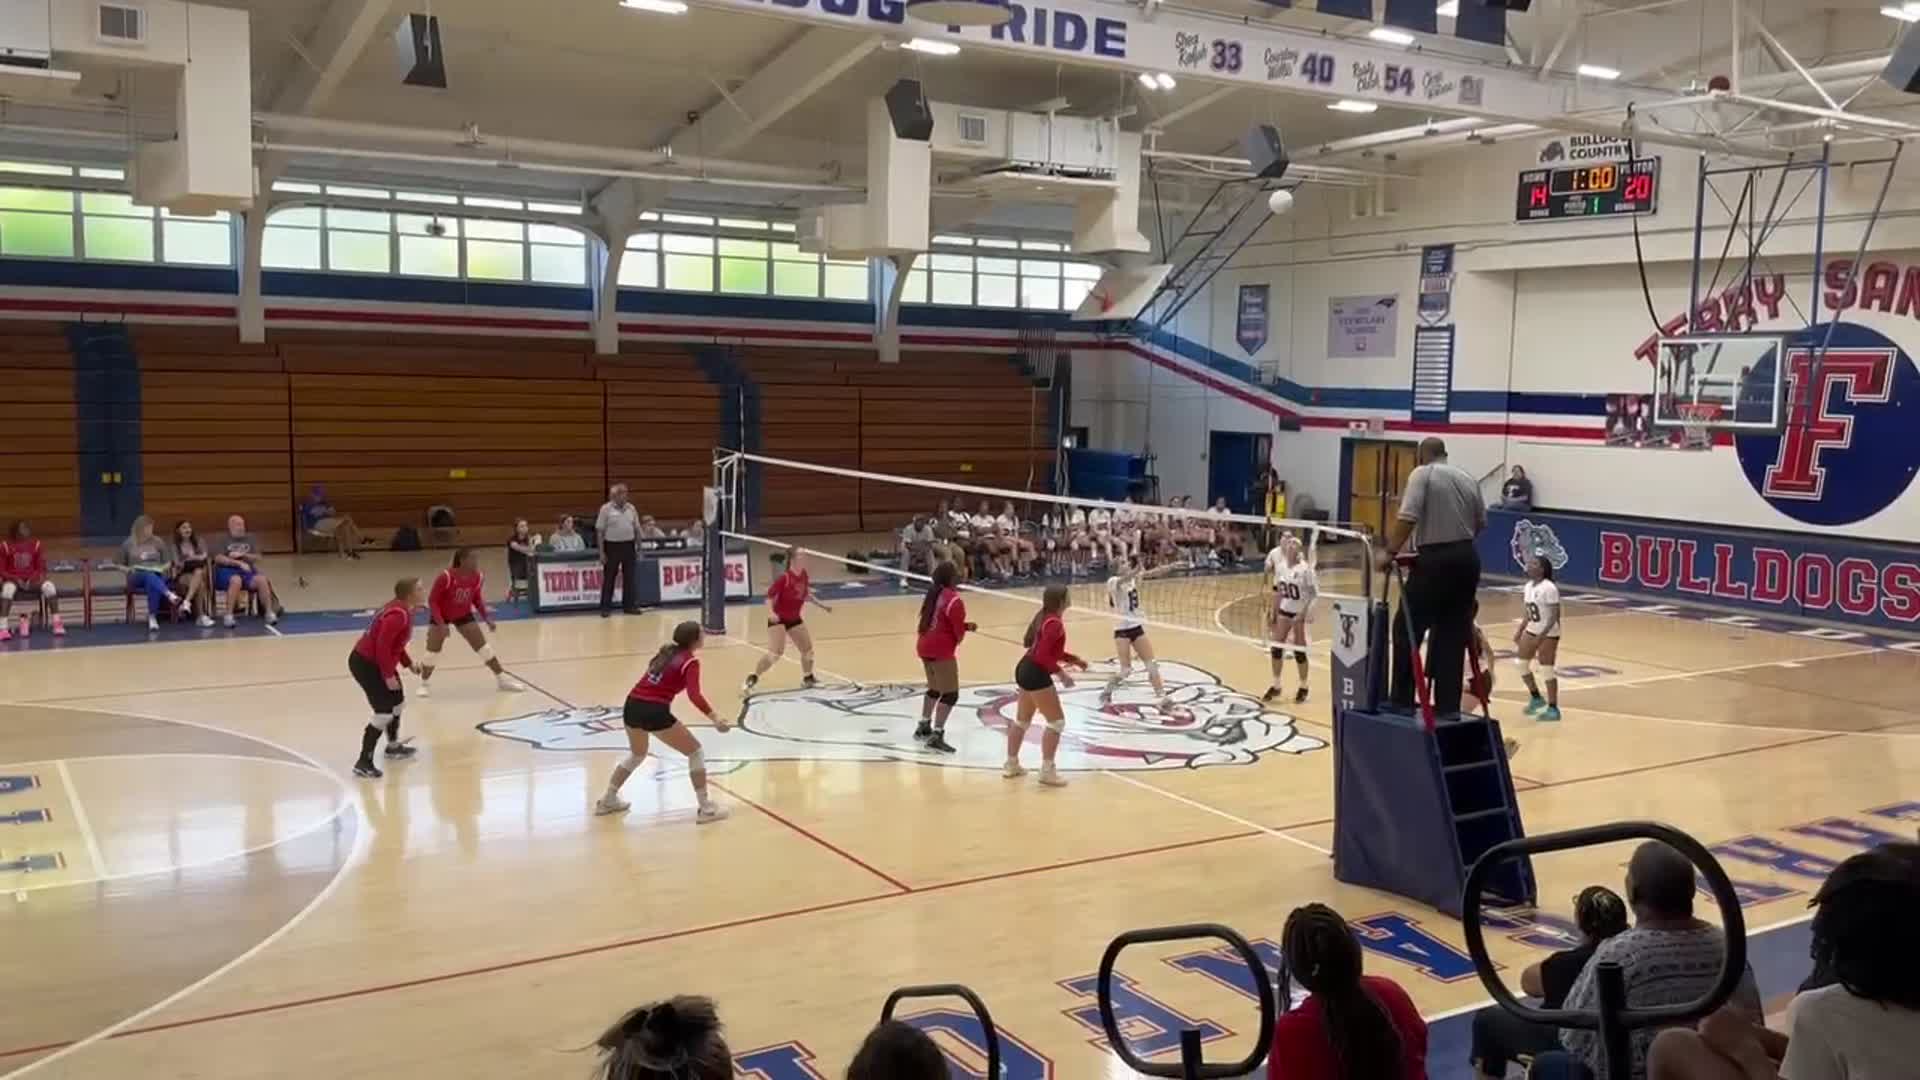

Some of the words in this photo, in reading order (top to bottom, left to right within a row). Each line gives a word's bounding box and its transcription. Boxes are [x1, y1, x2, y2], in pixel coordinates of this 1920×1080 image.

[944, 0, 1128, 58] RIDE
[1211, 40, 1243, 71] 33
[1301, 52, 1336, 85] 40
[1384, 62, 1415, 97] 54
[1571, 167, 1614, 191] 1:00
[1624, 175, 1652, 200] 20
[1530, 184, 1548, 208] 14
[1592, 196, 1600, 214] 1
[1762, 346, 1899, 502] F
[543, 570, 578, 593] TERRY
[1599, 530, 1920, 624] BULLDOGS
